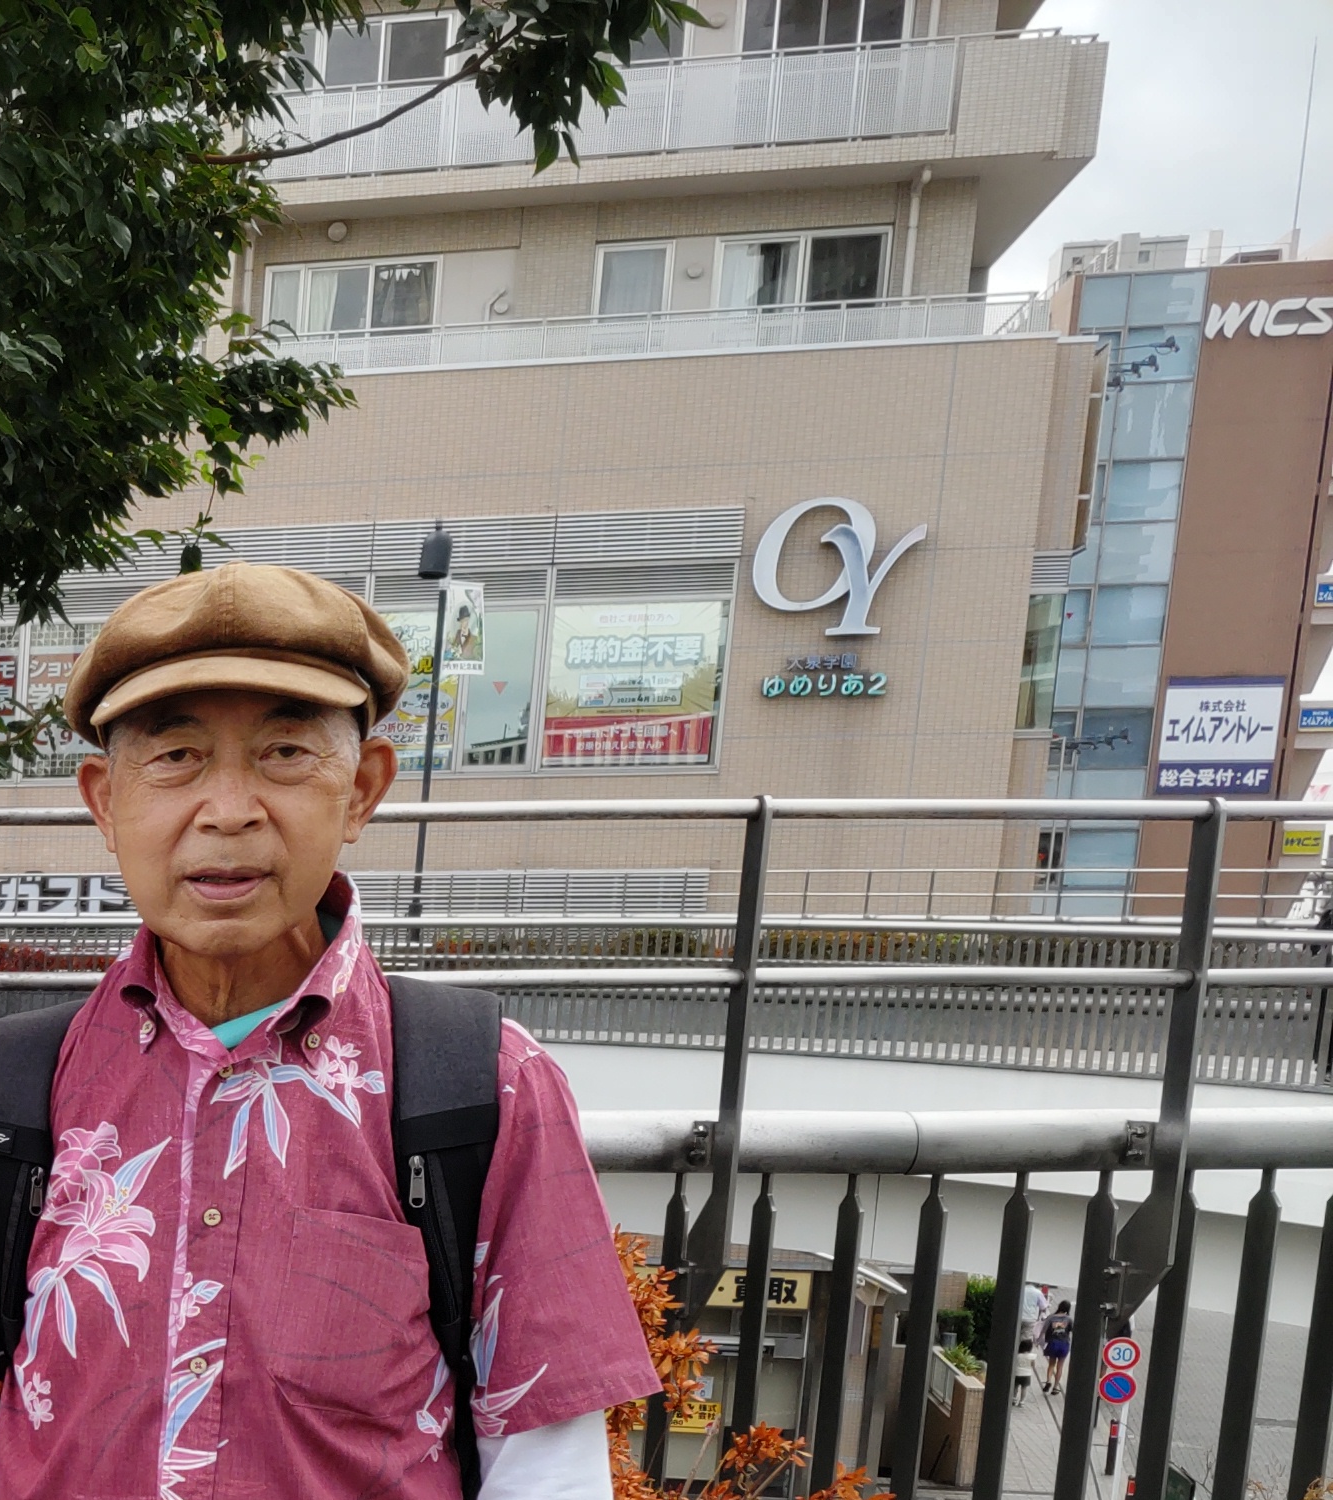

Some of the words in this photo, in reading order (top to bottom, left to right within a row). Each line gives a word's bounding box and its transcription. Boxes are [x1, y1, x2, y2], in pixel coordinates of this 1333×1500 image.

[1205, 298, 1333, 340] WICS
[566, 634, 704, 667] 解約金不要
[785, 652, 858, 671] 大泉学園
[762, 672, 888, 699] ゆめりあ2
[1198, 699, 1248, 713] 株式会社
[1165, 715, 1274, 745] エイムアントレー
[1284, 835, 1322, 848] WICS
[1111, 1347, 1133, 1362] 30
